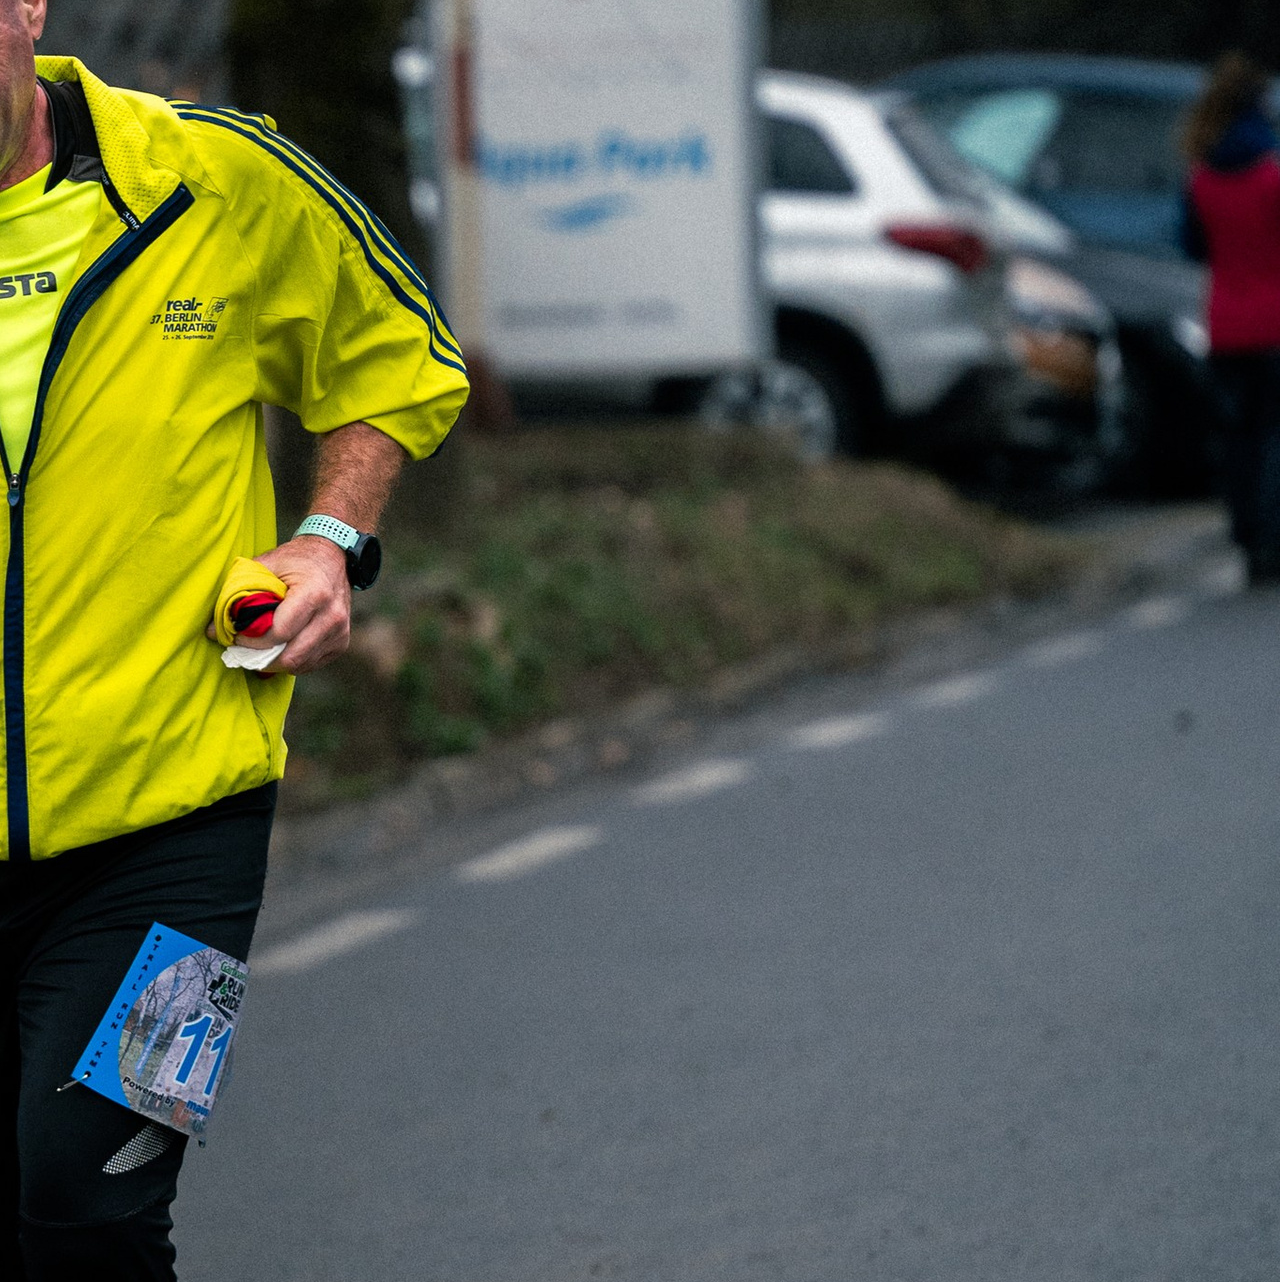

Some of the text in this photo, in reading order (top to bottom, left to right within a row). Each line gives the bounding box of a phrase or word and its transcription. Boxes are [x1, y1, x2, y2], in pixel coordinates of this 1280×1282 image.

[163, 323, 218, 333] MARATHON
[164, 313, 202, 323] BERLIN
[227, 977, 246, 999] RUN
[219, 993, 241, 1013] RIDE
[110, 1002, 129, 1030] RUN
[89, 1040, 108, 1068] 7KM
[122, 1076, 176, 1108] Powered by
